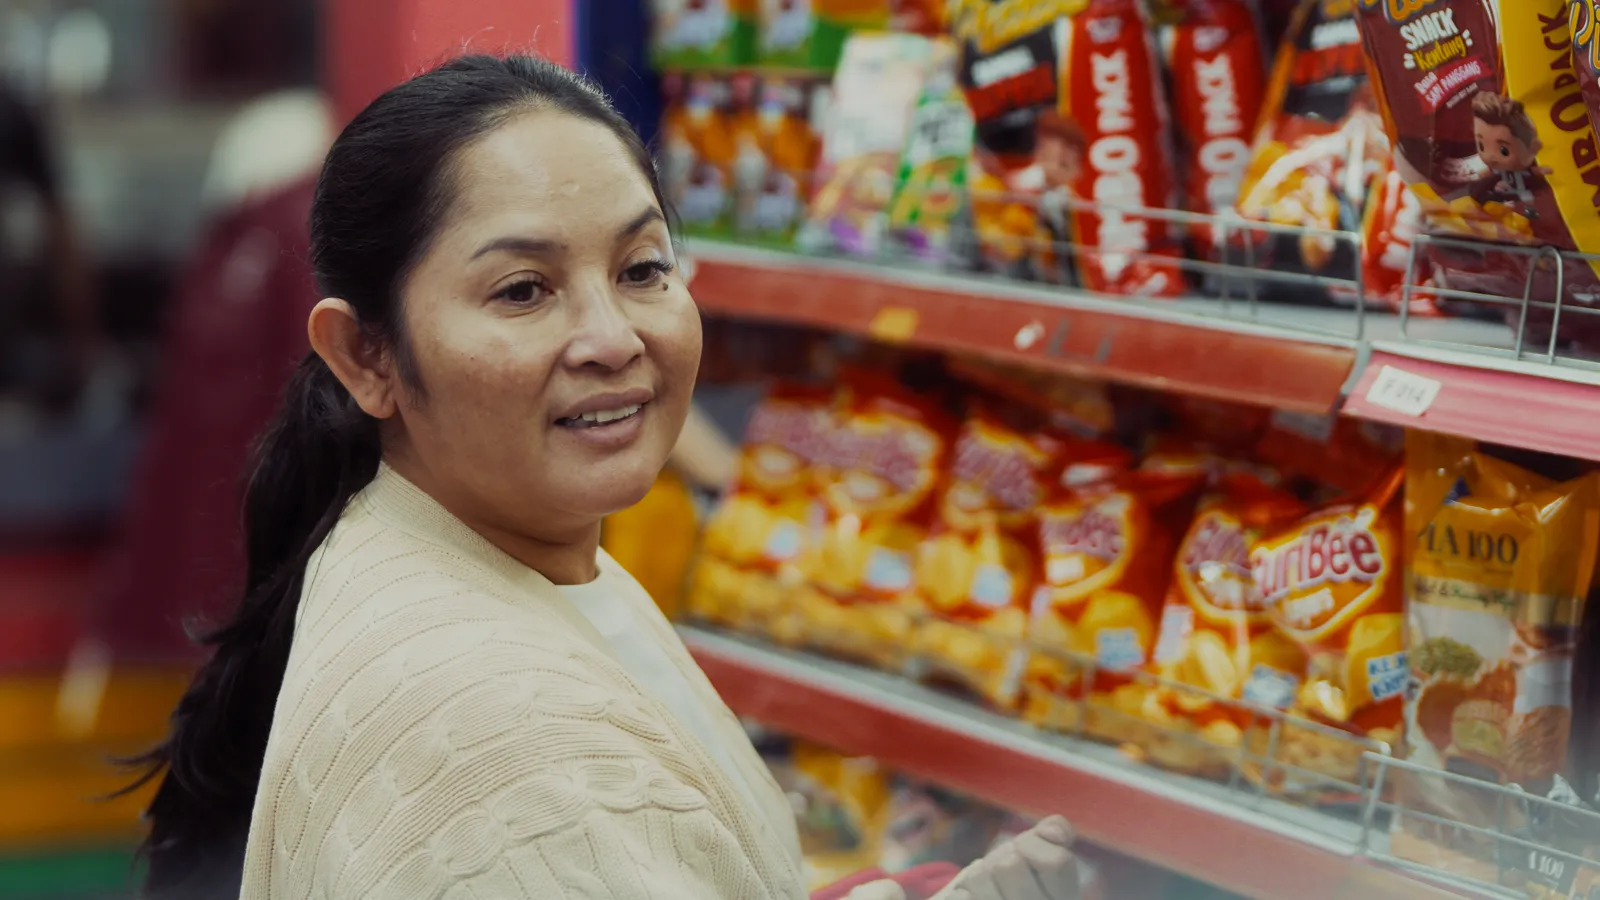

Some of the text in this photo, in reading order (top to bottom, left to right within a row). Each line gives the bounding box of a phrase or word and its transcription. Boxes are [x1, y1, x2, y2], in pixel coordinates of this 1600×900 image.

[1400, 7, 1459, 50] SNACK
[1538, 4, 1578, 91] PACK
[1413, 34, 1467, 72] Kentang
[1466, 529, 1520, 567] 100
